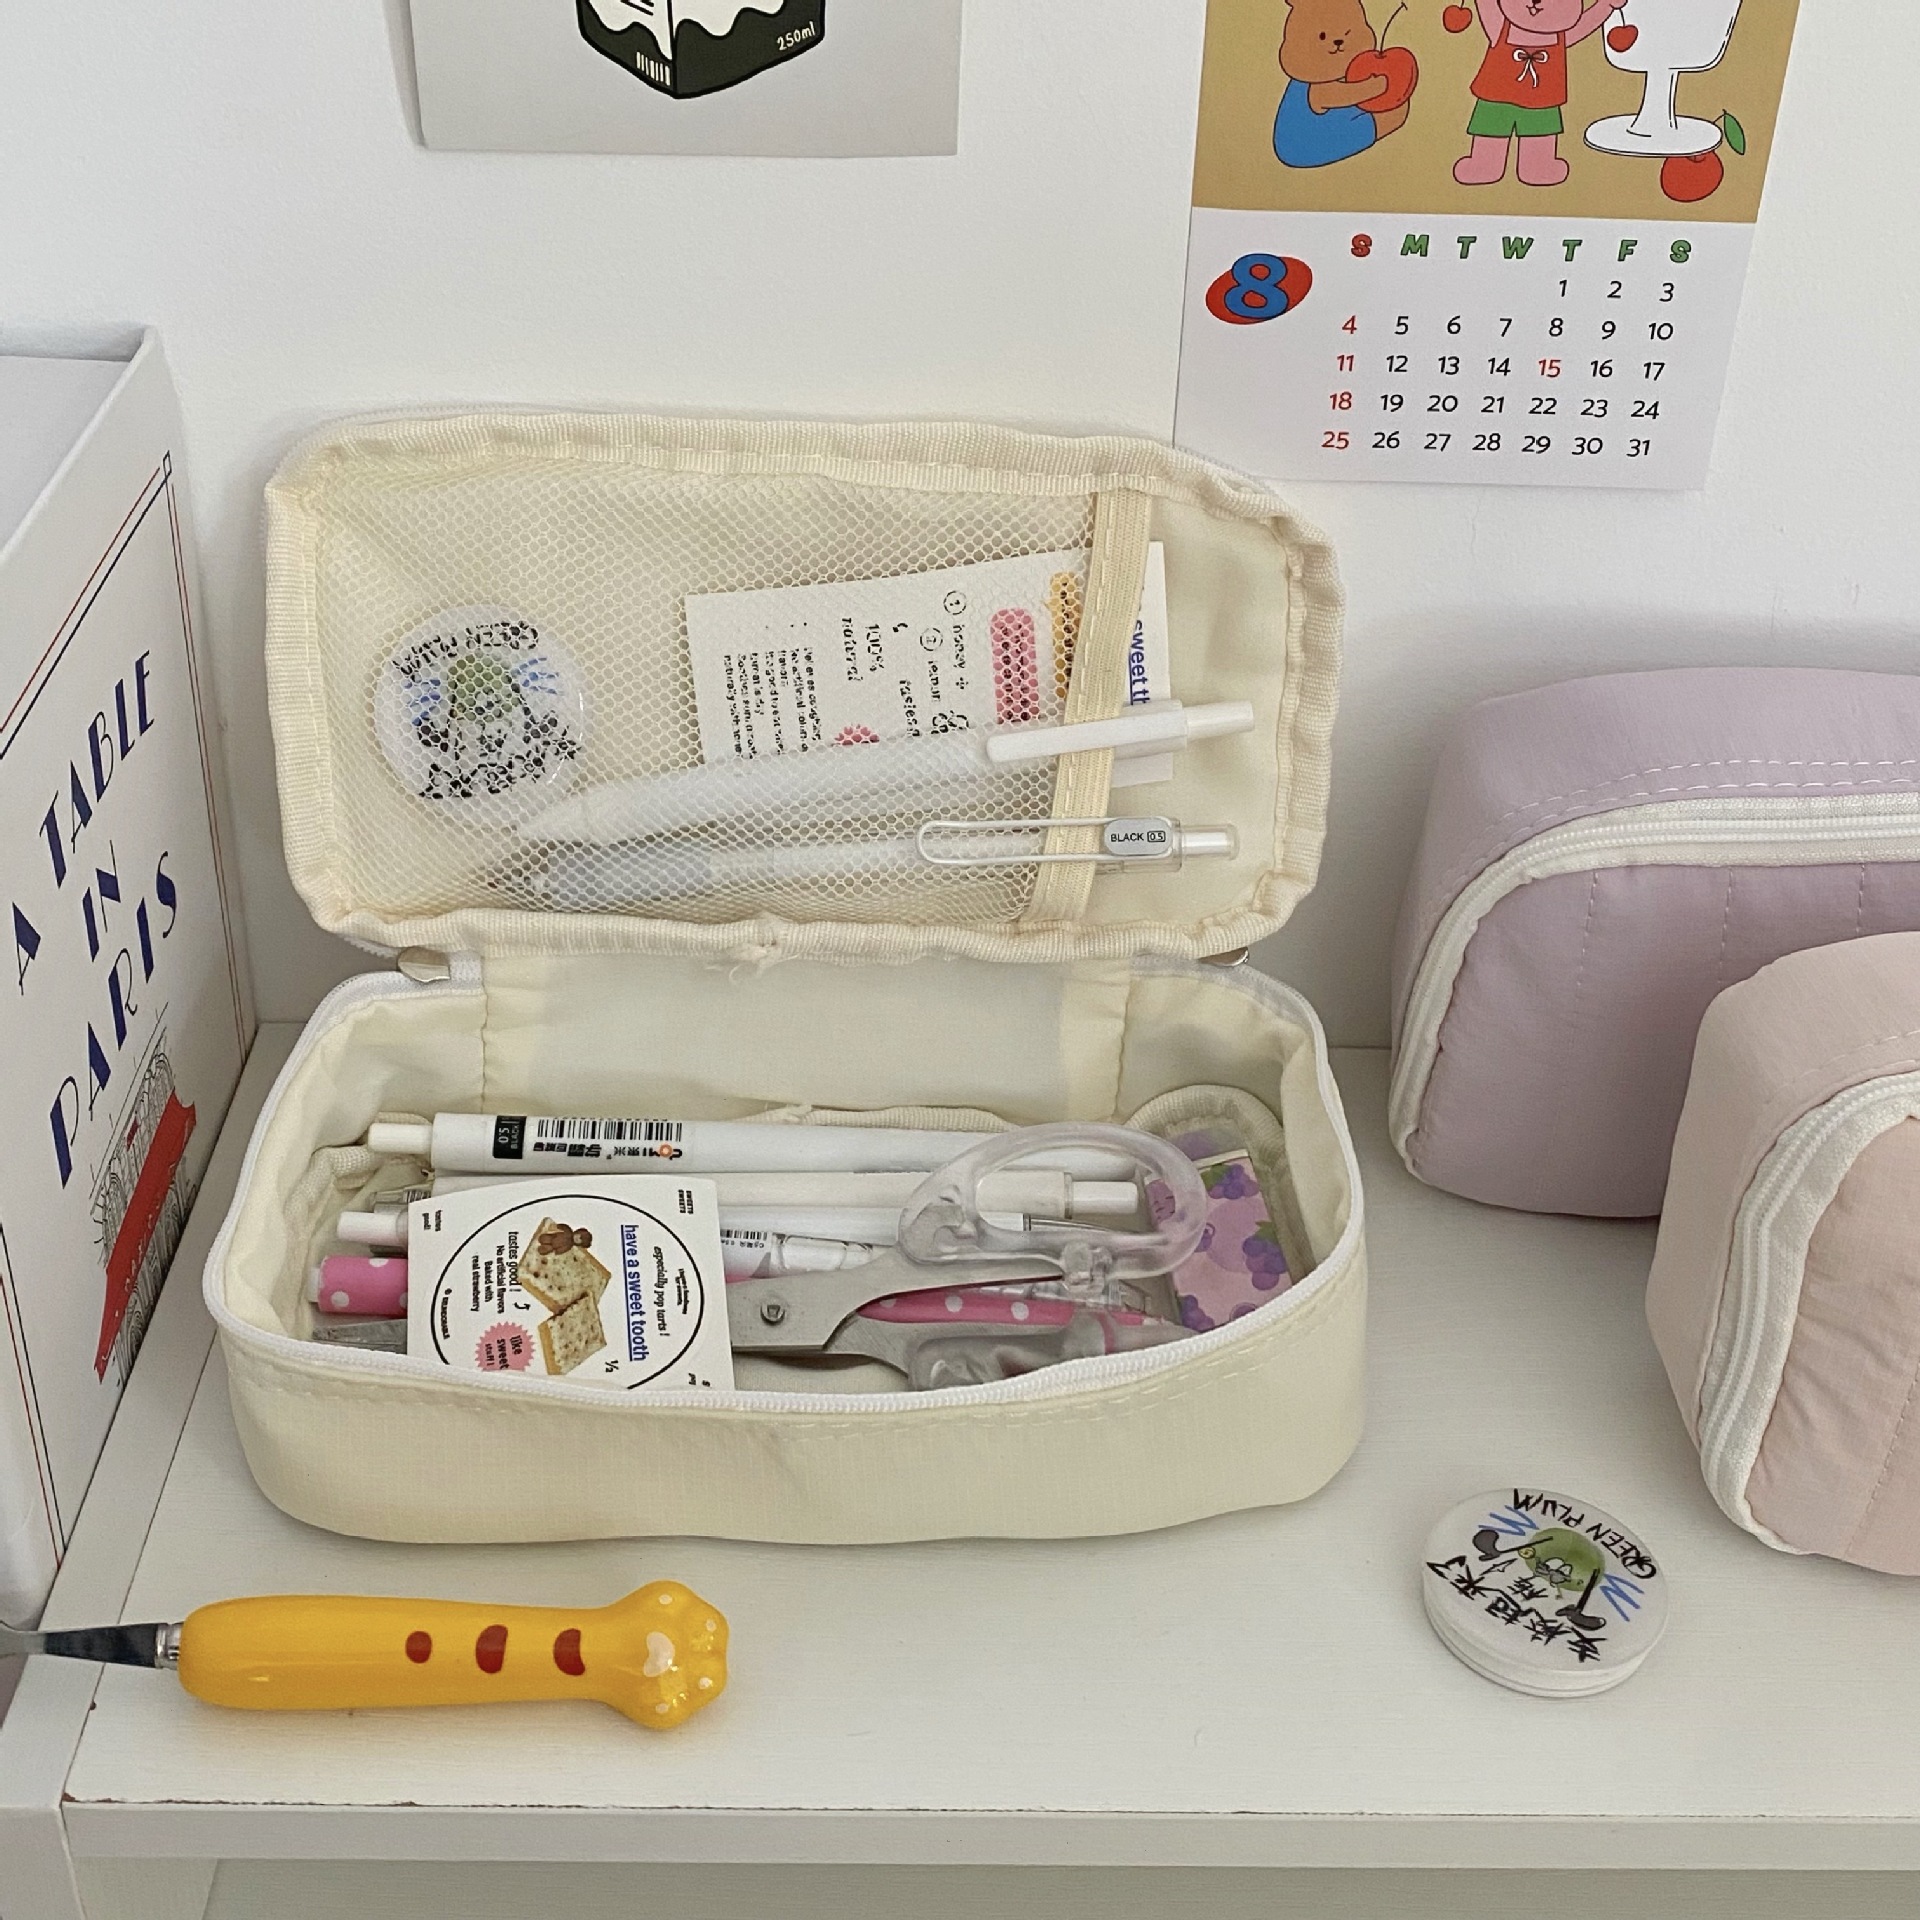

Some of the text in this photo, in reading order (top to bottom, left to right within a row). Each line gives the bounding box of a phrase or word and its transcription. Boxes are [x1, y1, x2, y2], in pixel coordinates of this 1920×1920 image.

[777, 21, 816, 51] 250ml
[1351, 234, 1691, 263] S M T W T F S
[1224, 253, 1291, 319] 8
[1559, 280, 1674, 302] 1 2 3
[1342, 315, 1673, 341] 4 5 6 7 8 9 10
[1337, 355, 1665, 381] 11 12 13 14 15 16 17
[1330, 392, 1659, 419] 18 19 20 21 22 23 24
[1321, 431, 1650, 457] 25 26 27 28 29 30 31
[12, 650, 154, 996] A TABLE
[1111, 833, 1165, 843] BLACK 0.5
[82, 840, 122, 963] IN
[49, 851, 178, 1190] PARIS
[508, 1231, 519, 1259] tastes
[484, 1260, 494, 1302] Baked with
[496, 1245, 507, 1314] No artificial flavors
[506, 1261, 521, 1286] good
[653, 1246, 668, 1288] especially
[470, 1255, 481, 1312] real strawberry
[623, 1225, 649, 1362] have a sweet tooth
[654, 1290, 664, 1307] pop
[657, 1309, 667, 1331] tarts
[497, 1338, 509, 1370] sweet
[510, 1335, 523, 1355] like
[1513, 1488, 1657, 1580] GREEN PLUM
